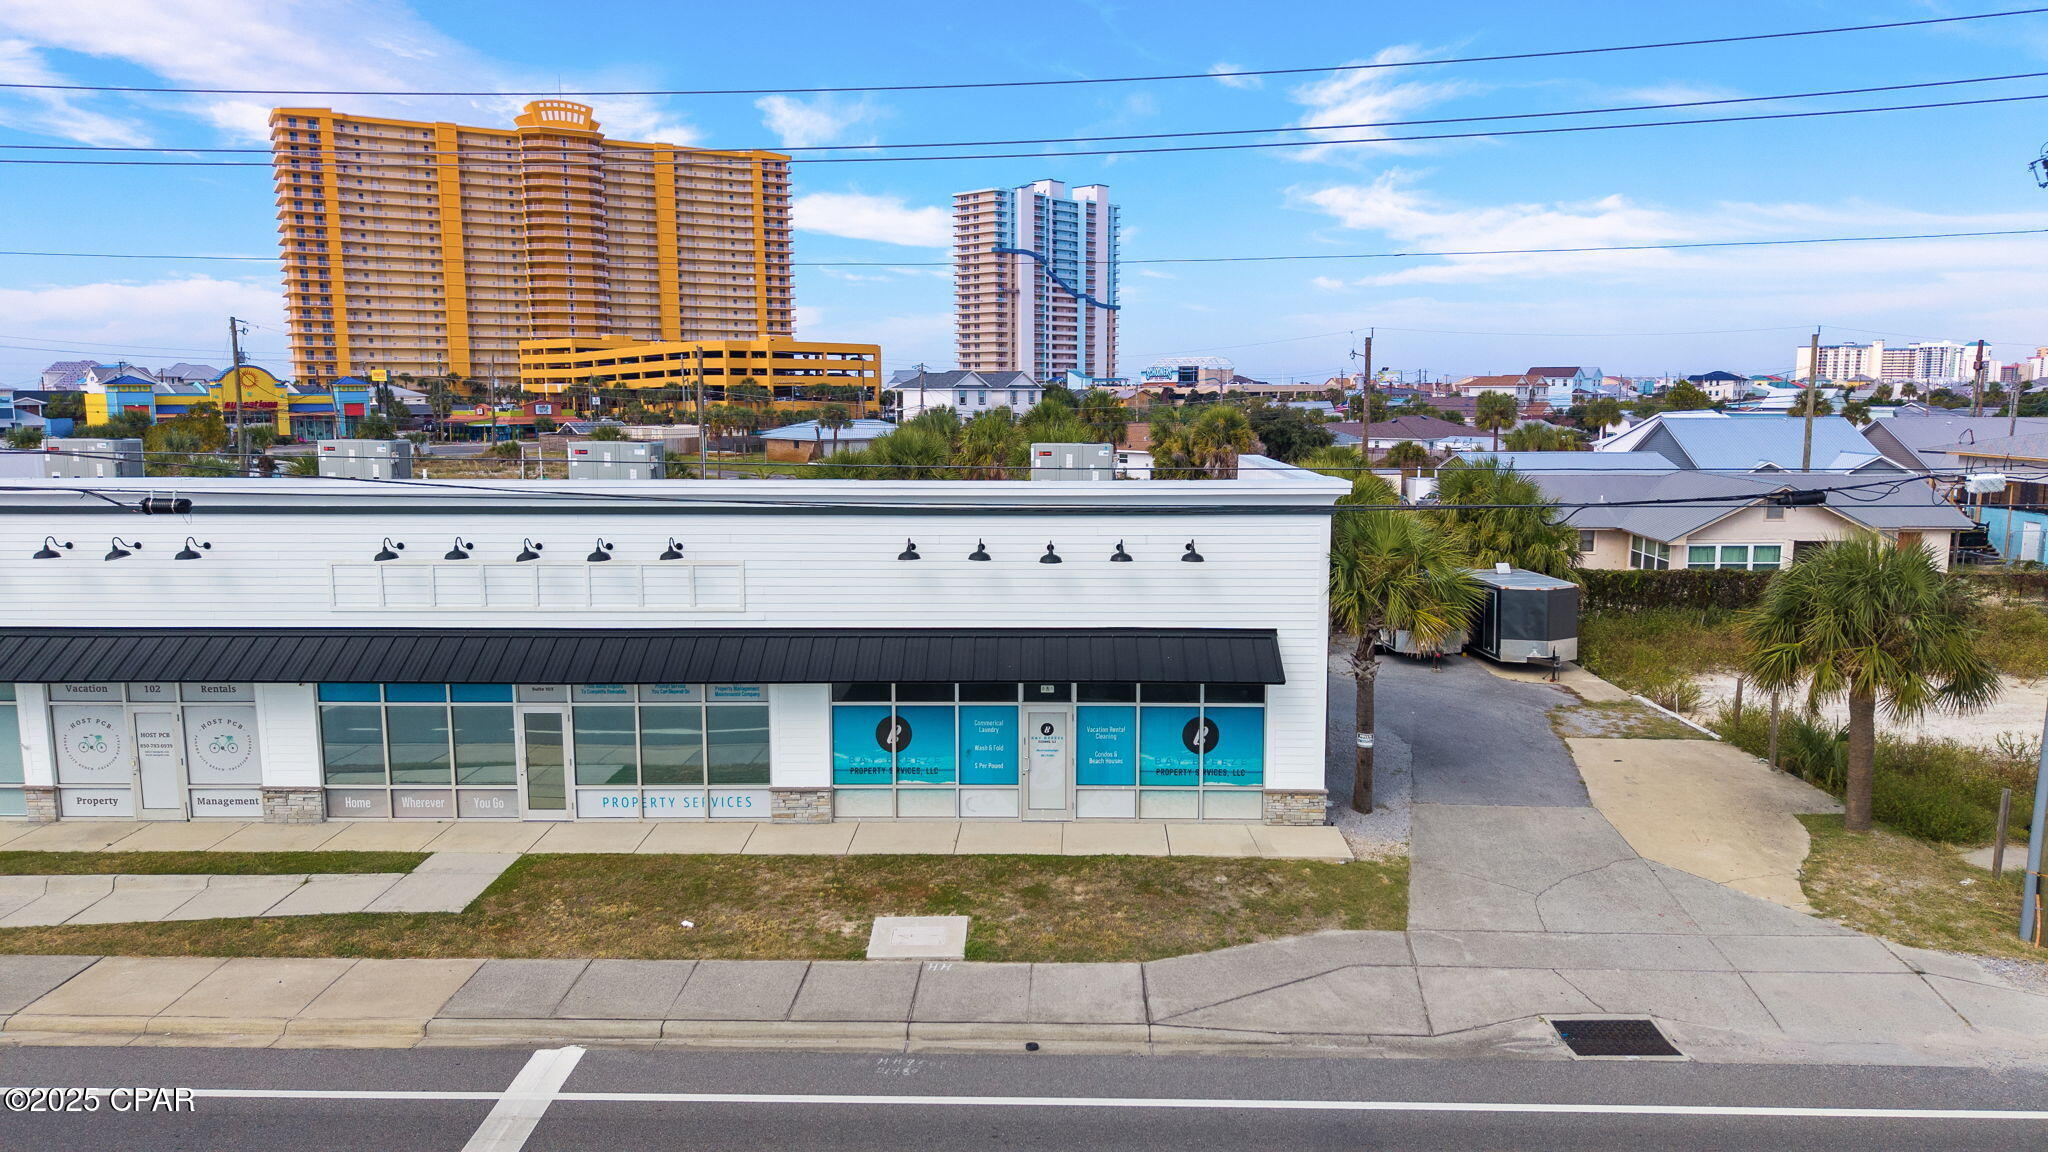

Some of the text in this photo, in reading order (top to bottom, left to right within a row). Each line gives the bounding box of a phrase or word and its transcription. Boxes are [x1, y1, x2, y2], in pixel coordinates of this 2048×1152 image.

[65, 684, 108, 693] Vacation
[144, 684, 161, 693] 102
[201, 684, 237, 693] Rentals
[69, 717, 113, 730] HOST PCB
[200, 718, 244, 730] HOST PCB
[1095, 733, 1117, 741] Cleaning
[850, 767, 886, 775] PROPERTY
[926, 767, 939, 775] LLC
[1233, 769, 1246, 777] LLC
[76, 797, 119, 807] Property
[197, 797, 260, 808] Management
[345, 797, 371, 809] Home
[401, 797, 445, 809] Wherever
[473, 797, 504, 809] You Go
[602, 796, 675, 808] PROPERTY
